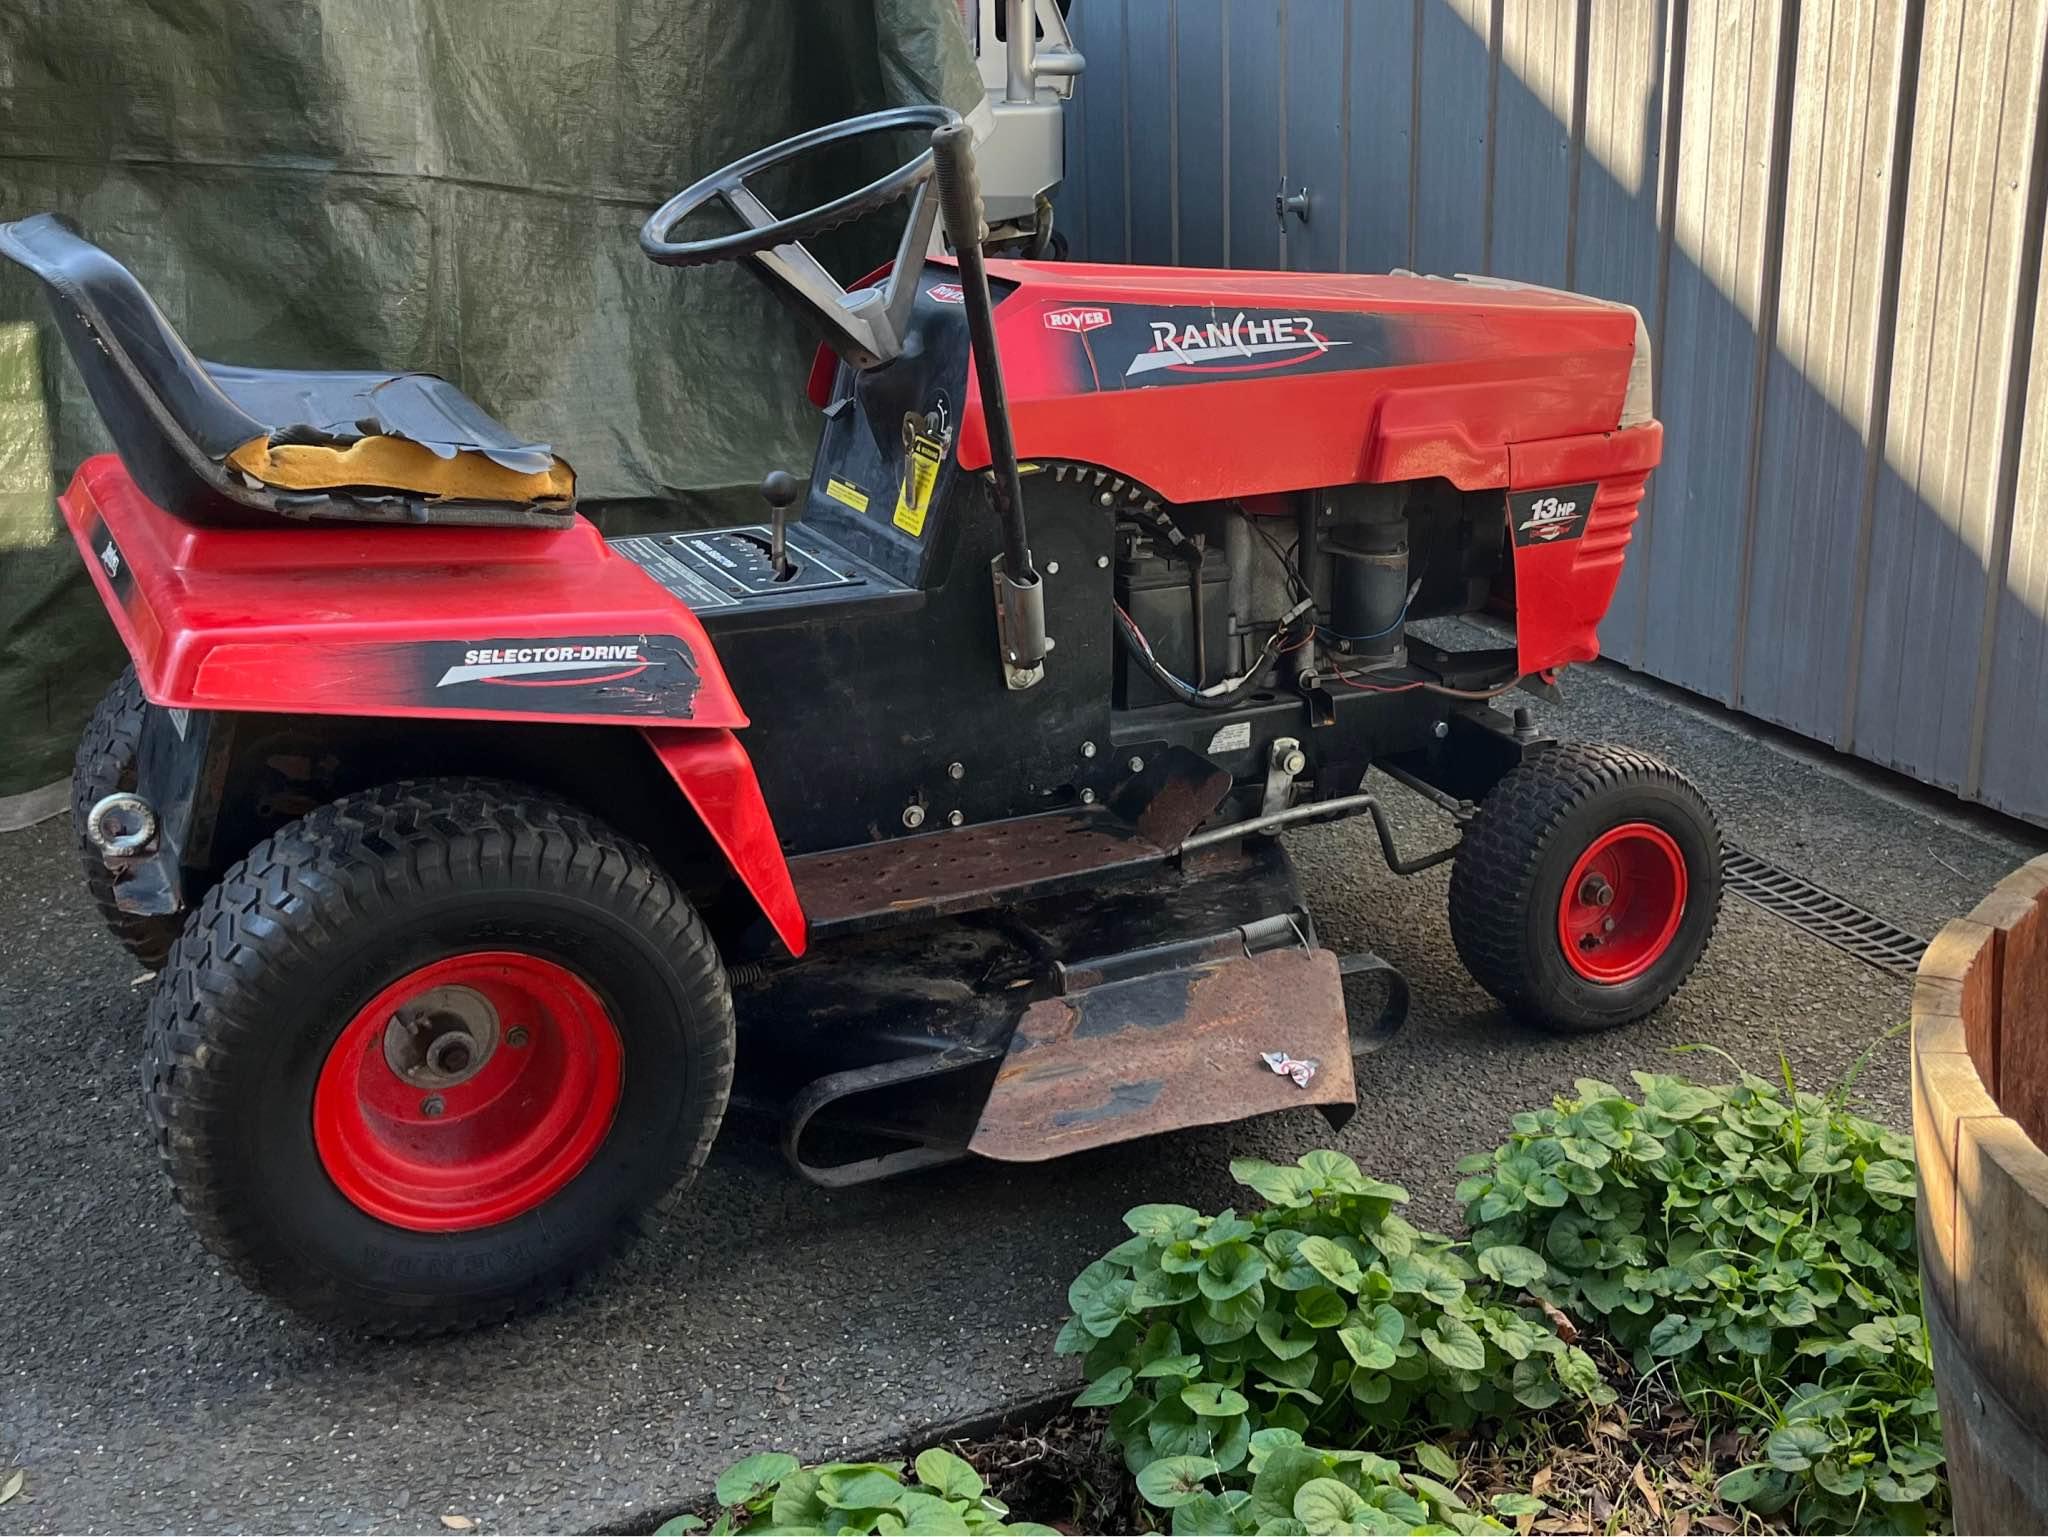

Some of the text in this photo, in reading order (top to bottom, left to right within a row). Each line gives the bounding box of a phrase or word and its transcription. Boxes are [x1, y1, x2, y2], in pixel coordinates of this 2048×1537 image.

[1050, 311, 1105, 330] ROVER
[1150, 312, 1329, 365] RANCHER
[464, 646, 639, 665] SELECTOR-DRIVE
